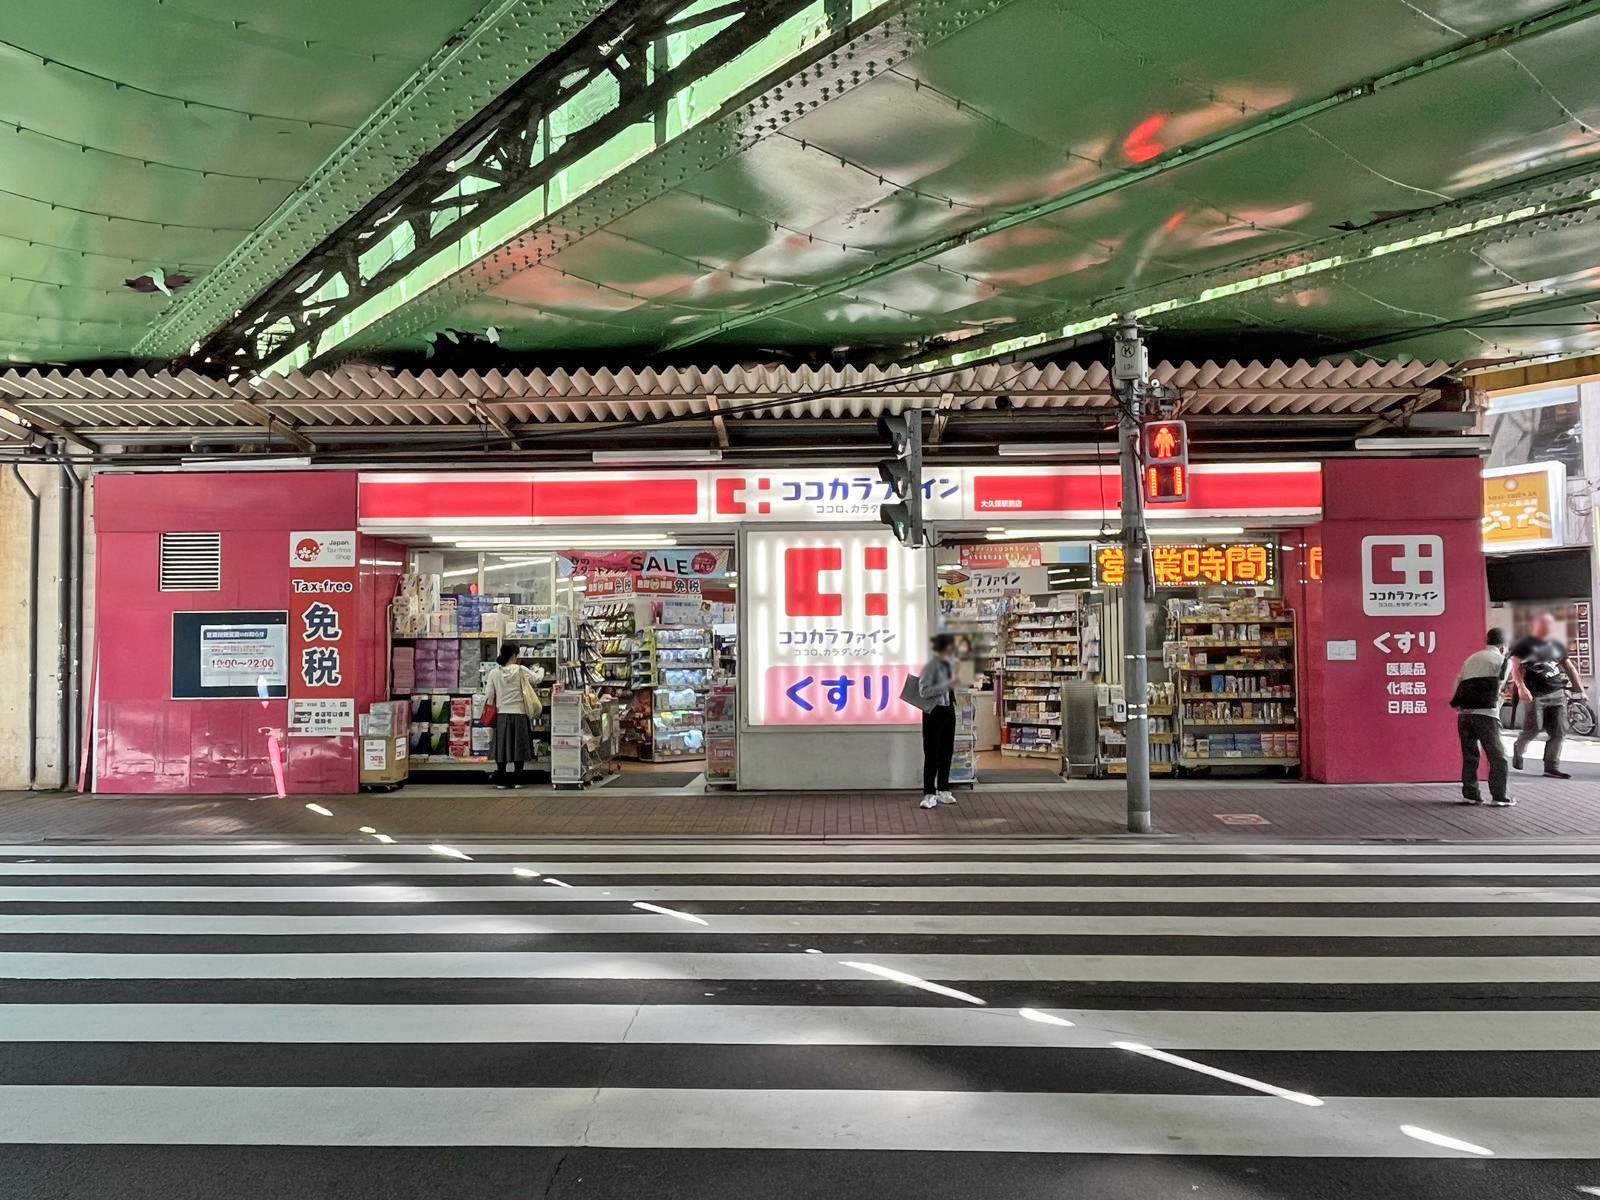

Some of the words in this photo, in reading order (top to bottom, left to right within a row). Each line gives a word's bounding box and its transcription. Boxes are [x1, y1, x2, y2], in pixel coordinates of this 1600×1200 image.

[782, 478, 960, 500] ココカラフイン
[816, 504, 880, 514] ココロ、カラダ
[631, 557, 689, 575] SALE
[1099, 547, 1266, 582] 営業時間
[292, 580, 352, 592] Tax-free
[674, 578, 701, 594] 免税
[972, 572, 1020, 586] ラファイン
[1369, 591, 1438, 600] ココカラファイン
[302, 602, 342, 686] 免税
[779, 629, 896, 644] ココカラファイン
[1373, 631, 1436, 654] くすり
[1386, 662, 1426, 676] 医薬品
[786, 675, 889, 711] くすり
[1386, 681, 1427, 695] 化粧品
[1388, 700, 1427, 714] 日用品
